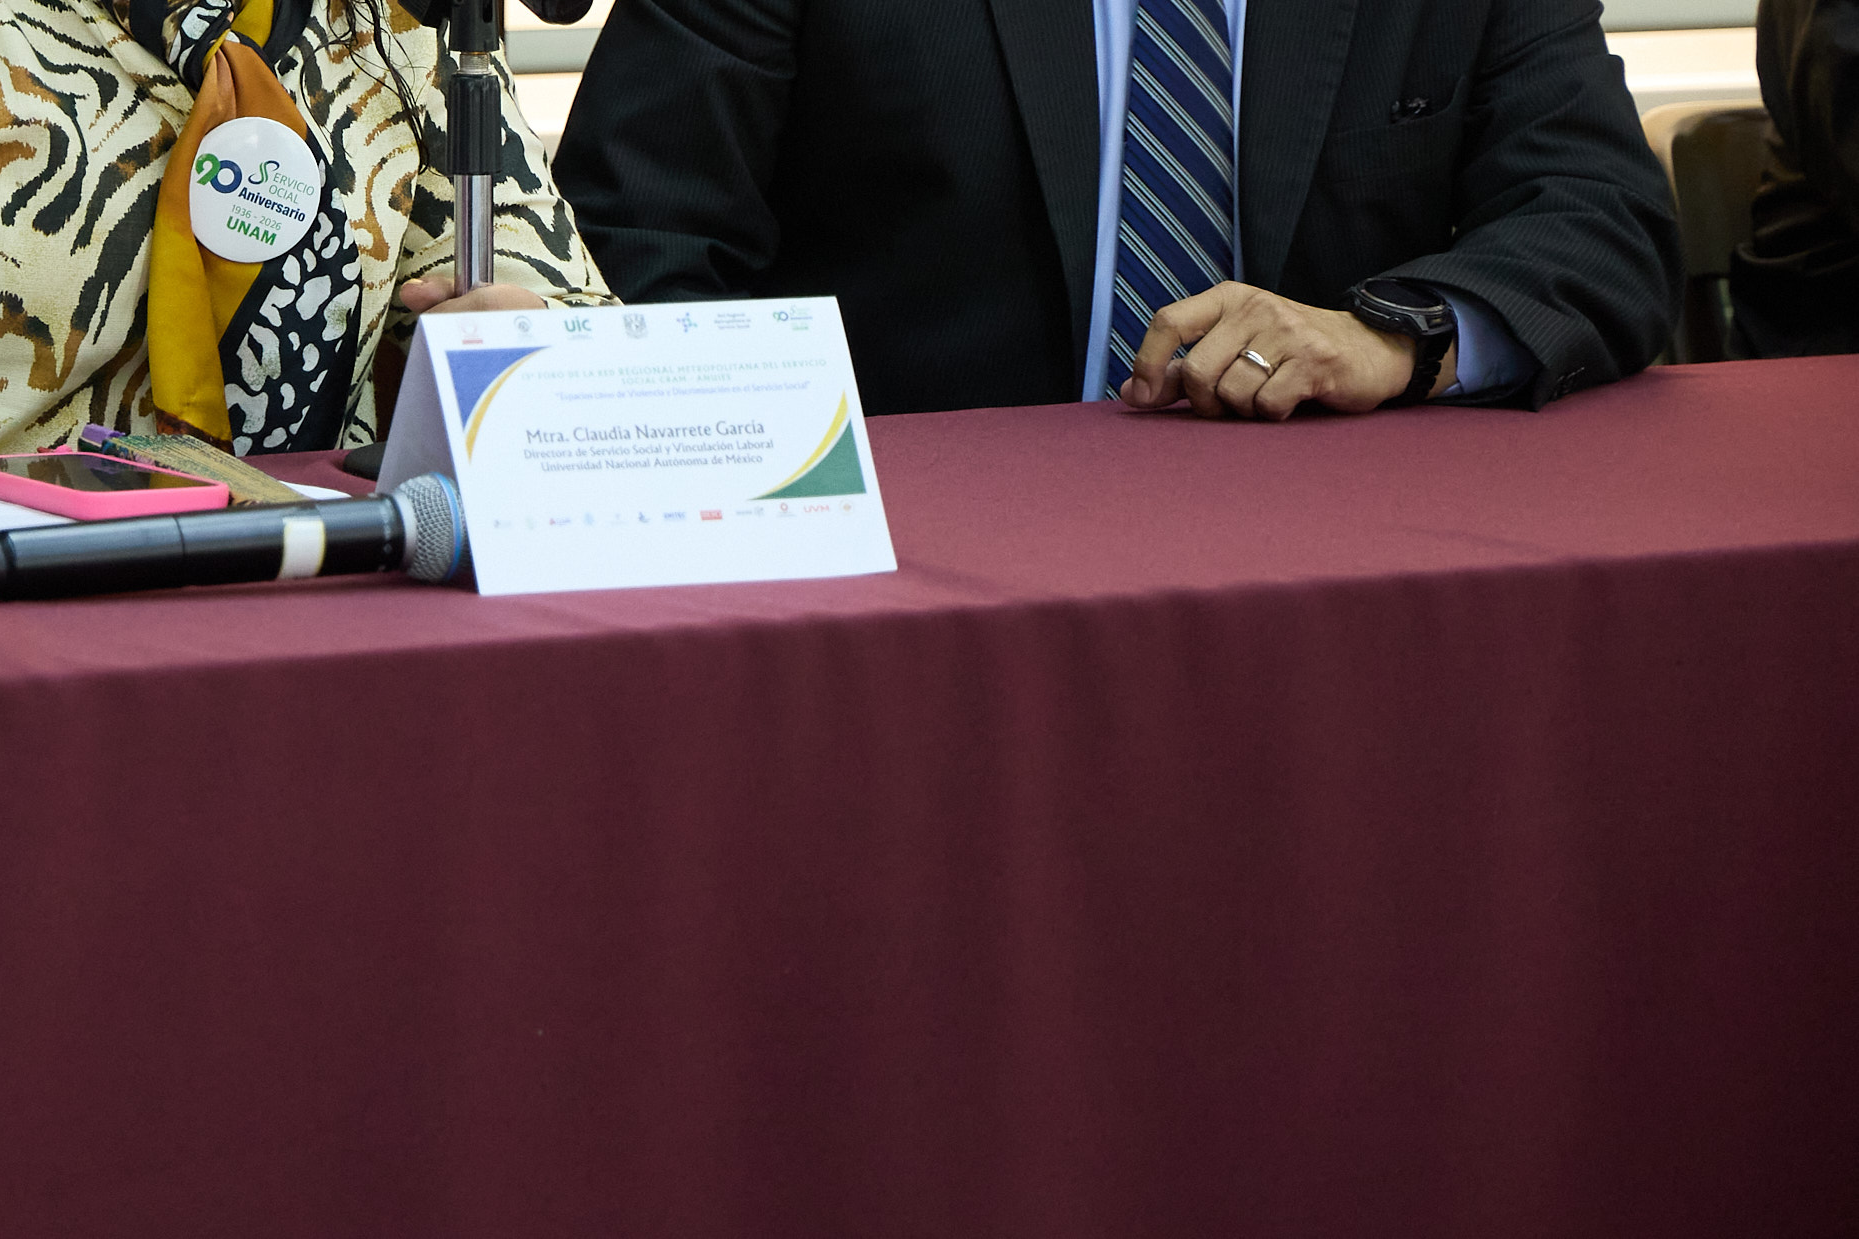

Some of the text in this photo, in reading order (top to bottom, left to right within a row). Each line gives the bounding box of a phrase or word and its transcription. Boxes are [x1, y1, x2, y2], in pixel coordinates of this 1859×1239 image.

[195, 153, 243, 194] 90
[238, 186, 306, 222] Aniversario
[231, 204, 251, 219] 1936
[259, 215, 283, 231] 2026
[226, 216, 277, 246] UNAM
[618, 365, 674, 376] REGIONAL
[677, 362, 759, 372] METROPOLITANA
[762, 361, 779, 369] DEL
[781, 359, 827, 368] SERVICIO
[526, 429, 570, 444] Mtra.
[573, 426, 631, 442] Claudia
[635, 424, 712, 440] Navarrete
[524, 448, 573, 459] Directora
[575, 447, 588, 457] de
[589, 445, 630, 457] Servicio
[632, 443, 662, 455] Social
[672, 441, 734, 453] Vinculación
[736, 439, 774, 450] Laboral
[541, 453, 763, 472] Universidad Nacional Autónoma de México
